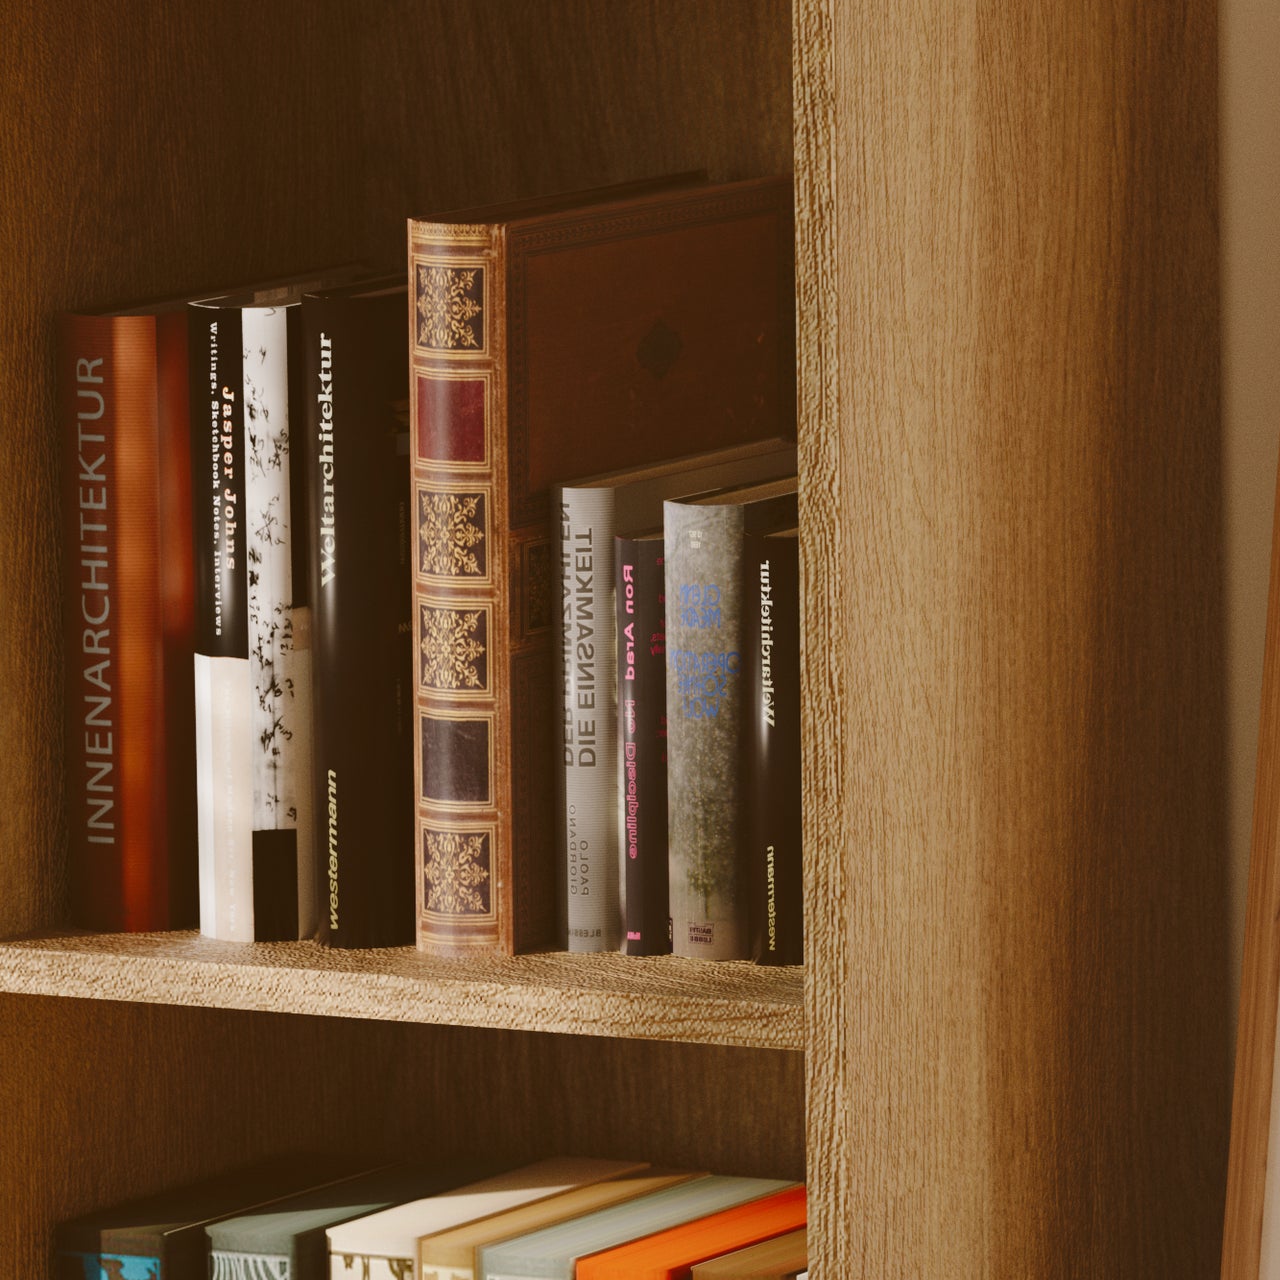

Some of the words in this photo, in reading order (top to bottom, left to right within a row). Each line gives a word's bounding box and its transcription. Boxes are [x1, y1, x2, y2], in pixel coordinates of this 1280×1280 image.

[211, 401, 221, 489] Sketchbook
[220, 387, 236, 480] Jasper
[318, 332, 336, 589] Weltarchitektur
[223, 489, 237, 570] Johns
[76, 356, 116, 845] INNENARCHITEKTUR
[214, 551, 224, 636] Interviews
[328, 769, 338, 931] westermann
